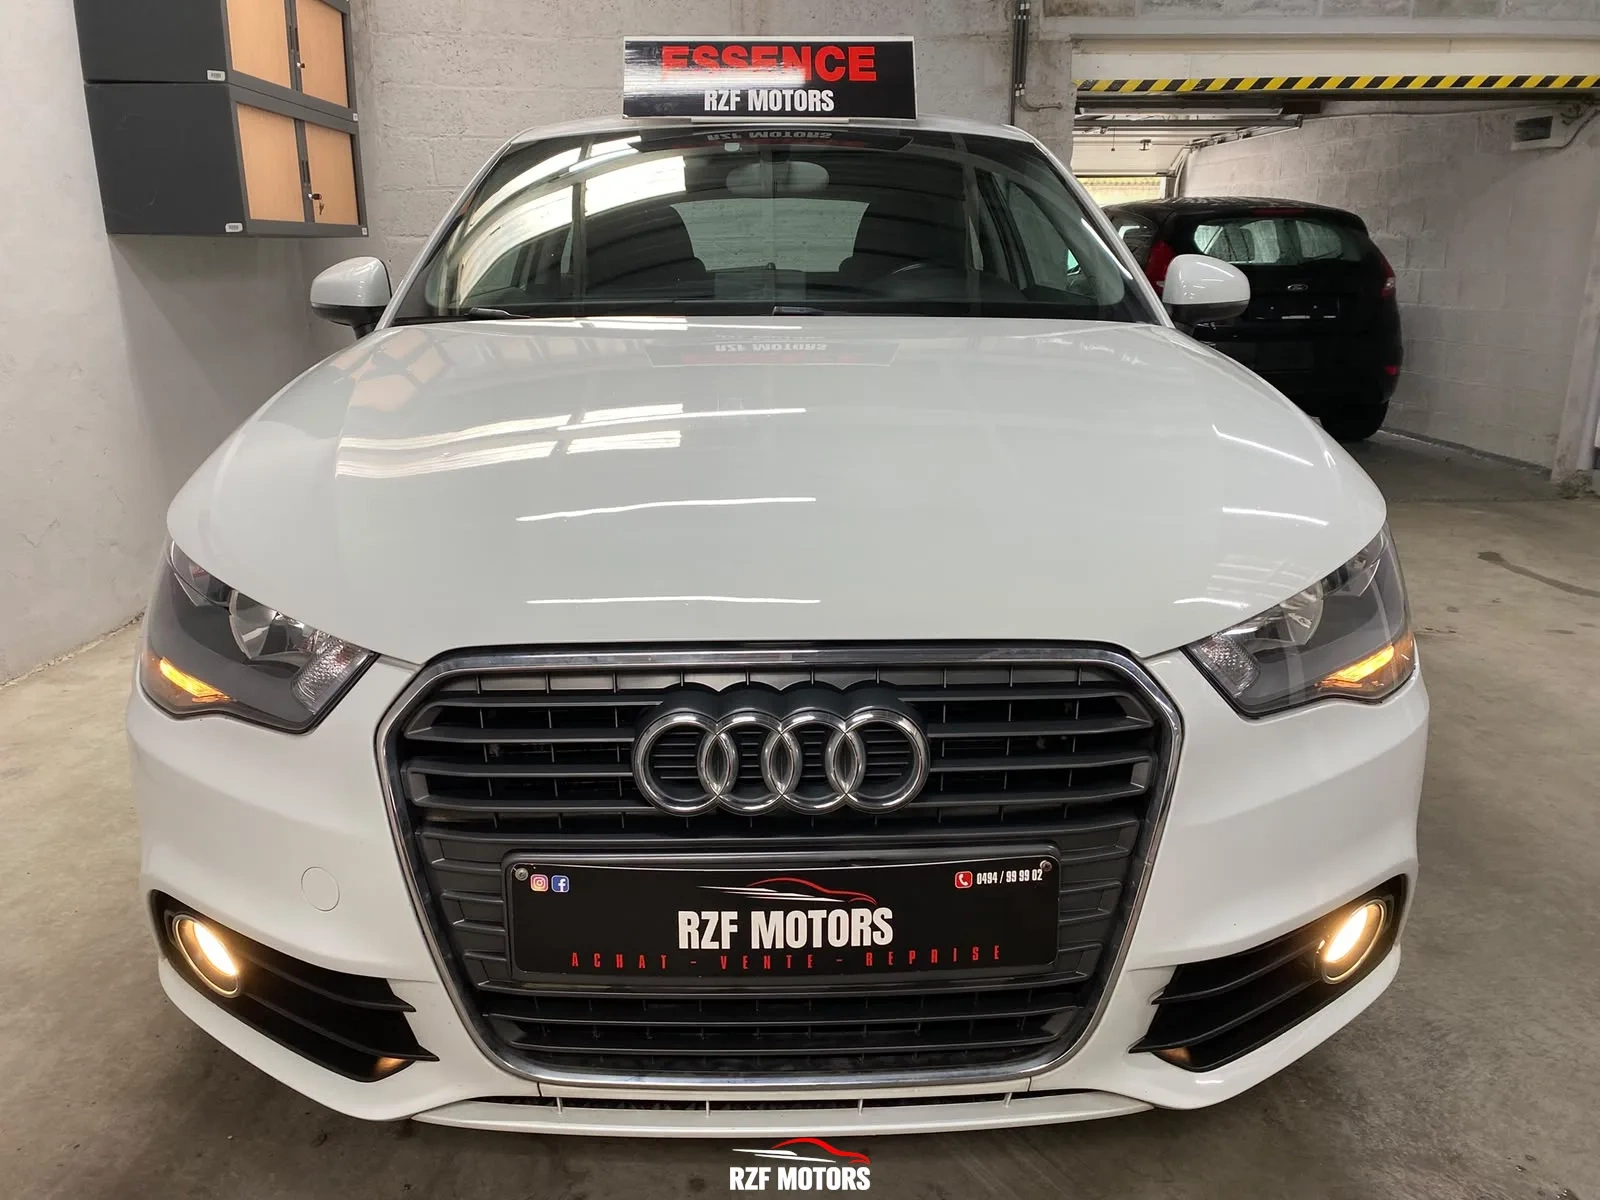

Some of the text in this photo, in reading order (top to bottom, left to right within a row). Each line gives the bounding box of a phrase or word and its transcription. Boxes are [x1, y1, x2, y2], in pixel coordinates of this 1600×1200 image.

[661, 45, 877, 82] ESSENCE
[704, 89, 835, 111] RZF MOTORS
[976, 872, 998, 885] 0494
[1006, 870, 1017, 883] 99
[1018, 869, 1030, 882] 99
[1031, 868, 1043, 881] 02
[678, 907, 893, 950] RZF MOTORS
[571, 952, 667, 969] ACHAT
[720, 954, 813, 970] VENTE
[865, 945, 1000, 967] REPRISE
